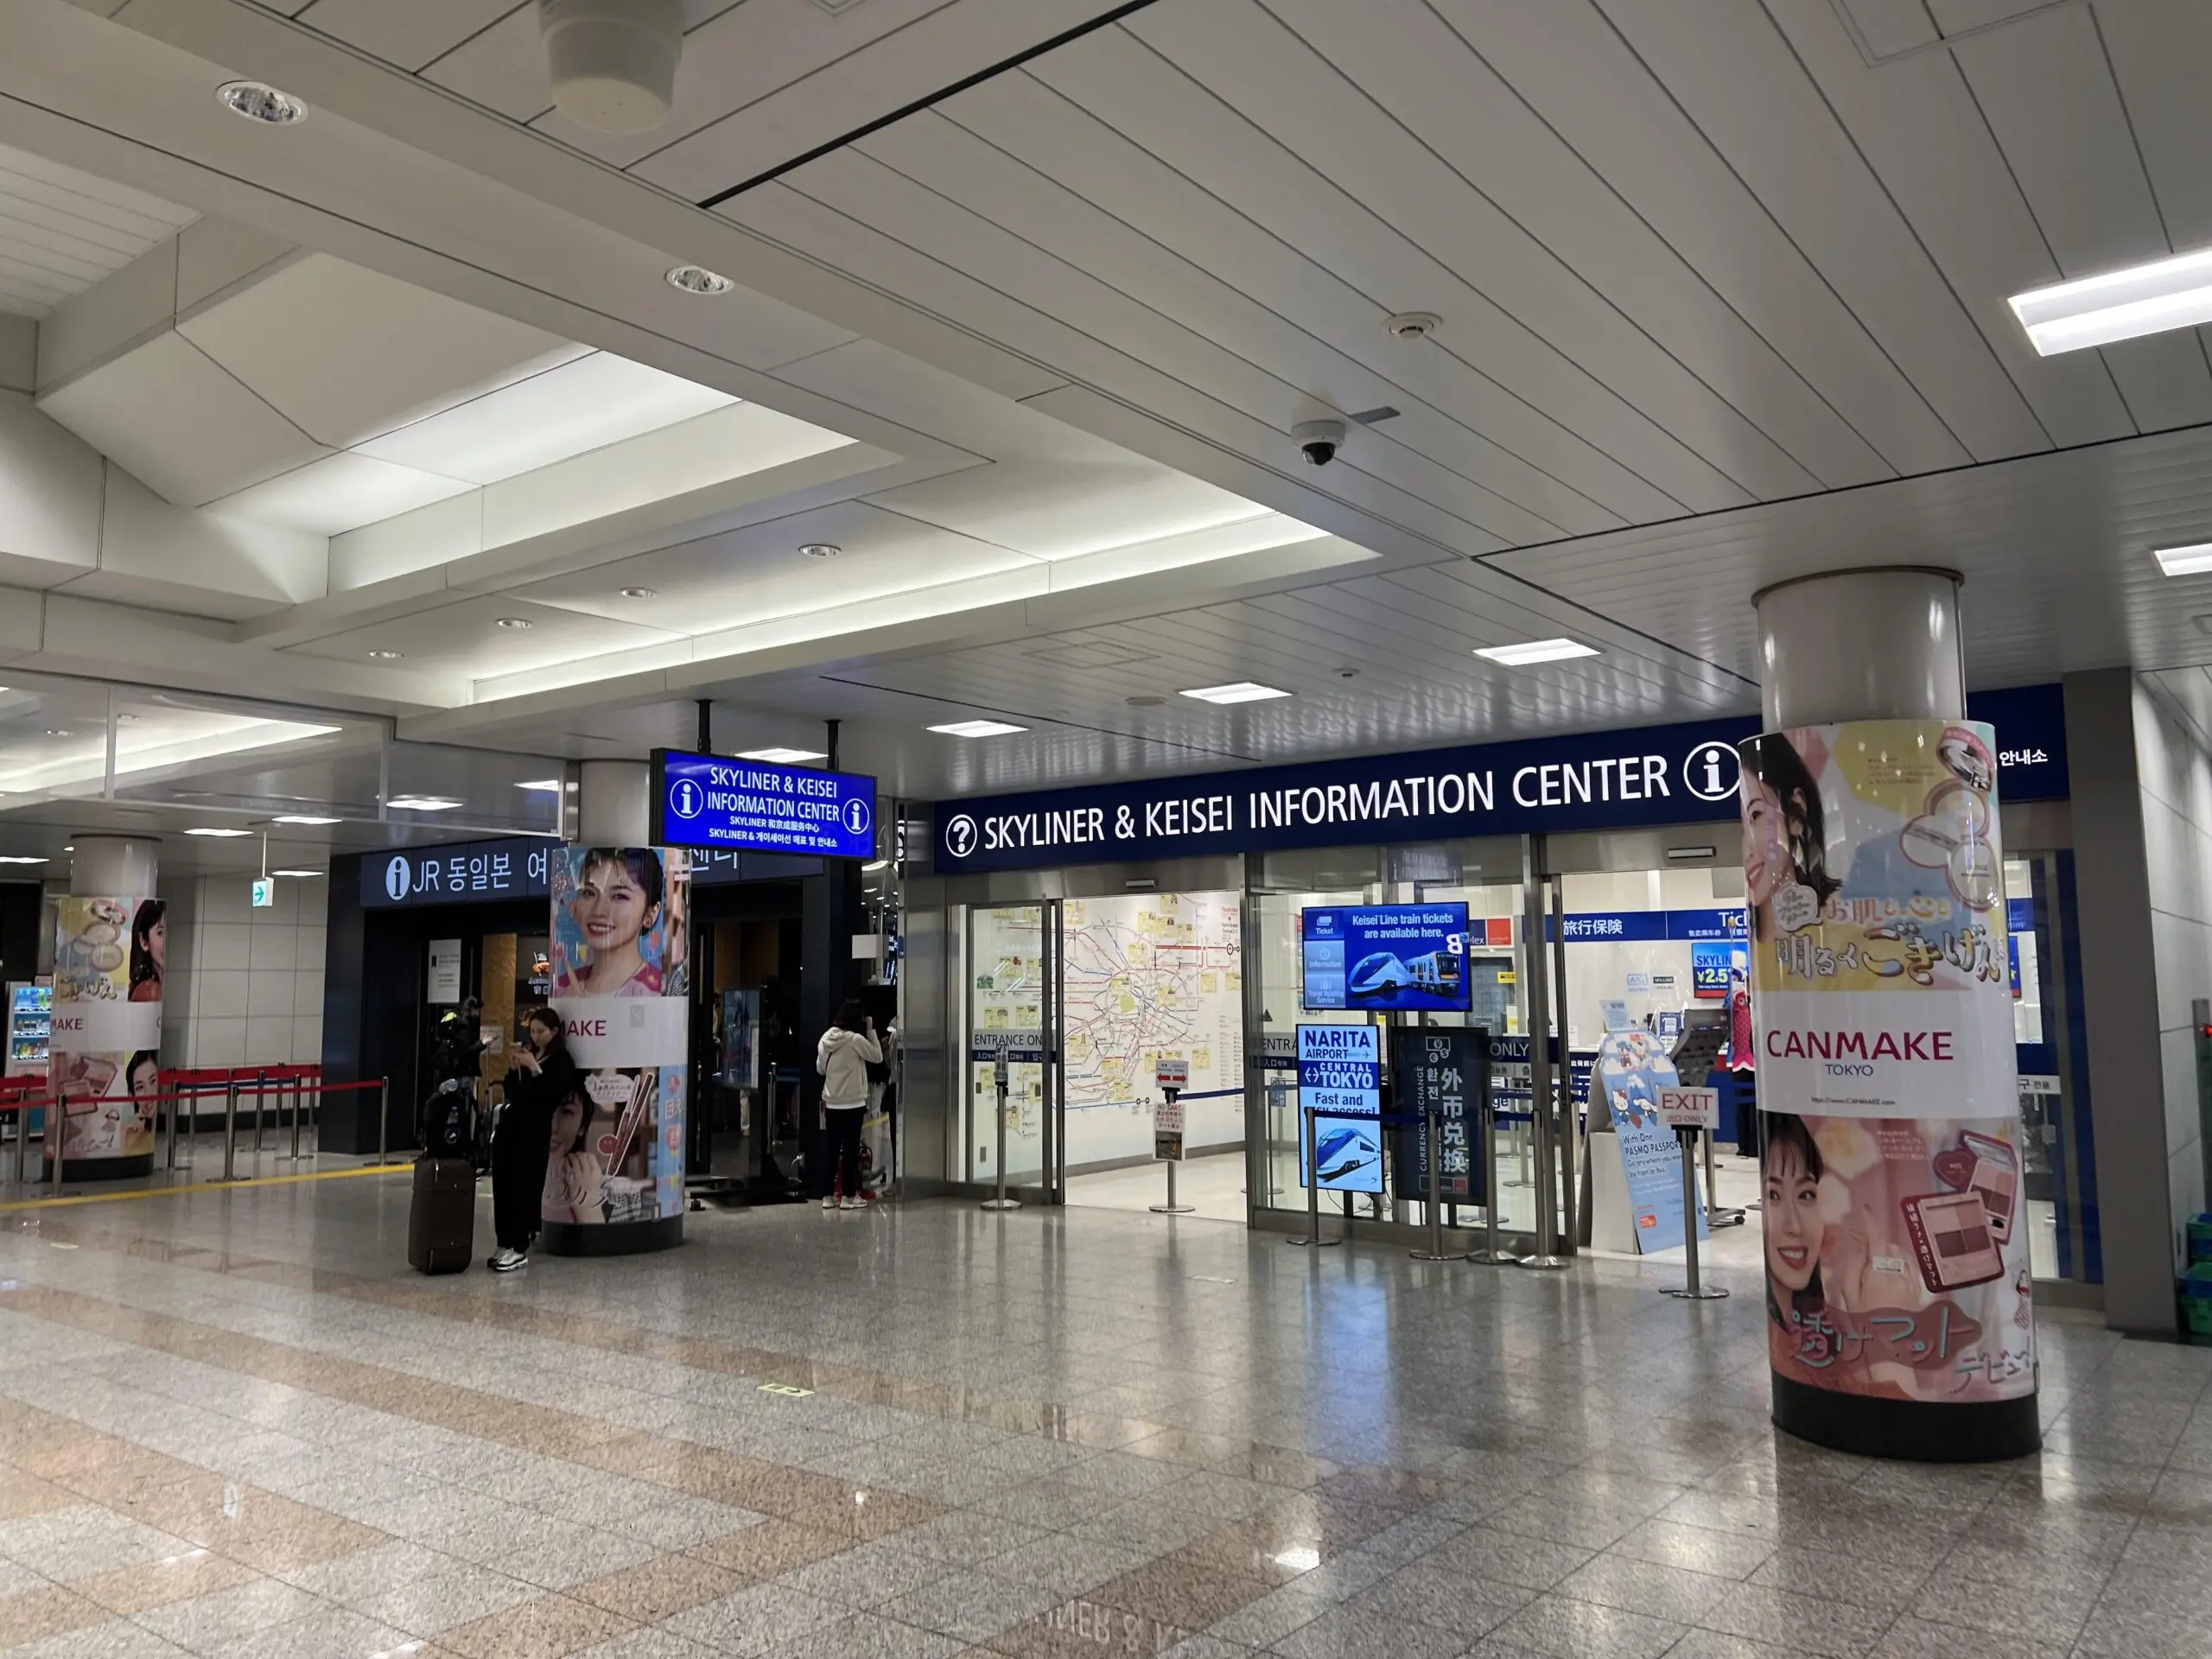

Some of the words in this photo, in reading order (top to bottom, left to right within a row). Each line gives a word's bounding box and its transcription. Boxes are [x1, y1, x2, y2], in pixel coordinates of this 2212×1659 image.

[1999, 748, 2049, 767] 안내소
[709, 766, 780, 791] SKYLINER
[784, 776, 794, 793] &
[798, 778, 837, 798] KEISEI
[708, 791, 795, 817] INFORMATION
[798, 801, 840, 822] CENTER
[984, 807, 1105, 849] SKYLINER
[1115, 805, 1135, 839] &
[1145, 795, 1233, 837] KEISEI
[1249, 770, 1494, 830] INFORMATION
[1512, 754, 1671, 808] CENTER
[729, 815, 766, 828] SKYLINER
[709, 828, 747, 840] SKYLINER
[817, 836, 838, 848] 안내소
[412, 860, 440, 893] JR
[447, 853, 512, 892] 동일본
[527, 848, 547, 885] 여
[1352, 914, 1379, 926] Keisei
[1380, 914, 1398, 925] Line
[1400, 913, 1421, 925] train
[1422, 912, 1453, 924] tickets
[1315, 927, 1334, 936] Ticket
[1364, 929, 1378, 938] are
[1380, 927, 1420, 938] available
[1421, 926, 1444, 938] here.
[1563, 919, 1623, 936] 旅行保険
[1309, 959, 1342, 968] Information
[1697, 955, 1731, 966] SKYLIN
[1697, 969, 1731, 983] ¥2,5
[975, 1034, 1024, 1046] ENTRANCE
[1027, 1034, 1042, 1046] ON
[1305, 1030, 1371, 1048] NARITA
[1767, 1030, 1954, 1061] CANMAKE
[1306, 1049, 1349, 1059] AIRPORT
[1490, 1042, 1529, 1057] ONLY
[1319, 1063, 1371, 1072] CENTRAL
[1825, 1064, 1874, 1077] TOKYO
[1319, 1071, 1374, 1089] TOKYO
[1416, 1065, 1425, 1116] EXCHANGE
[1315, 1092, 1338, 1104] Fast
[1342, 1094, 1363, 1105] and
[1662, 1093, 1713, 1110] EXIT
[1623, 1134, 1638, 1144] With
[1639, 1133, 1653, 1142] One
[1624, 1145, 1649, 1155] PASMO
[1650, 1141, 1681, 1153] PASSPOR
